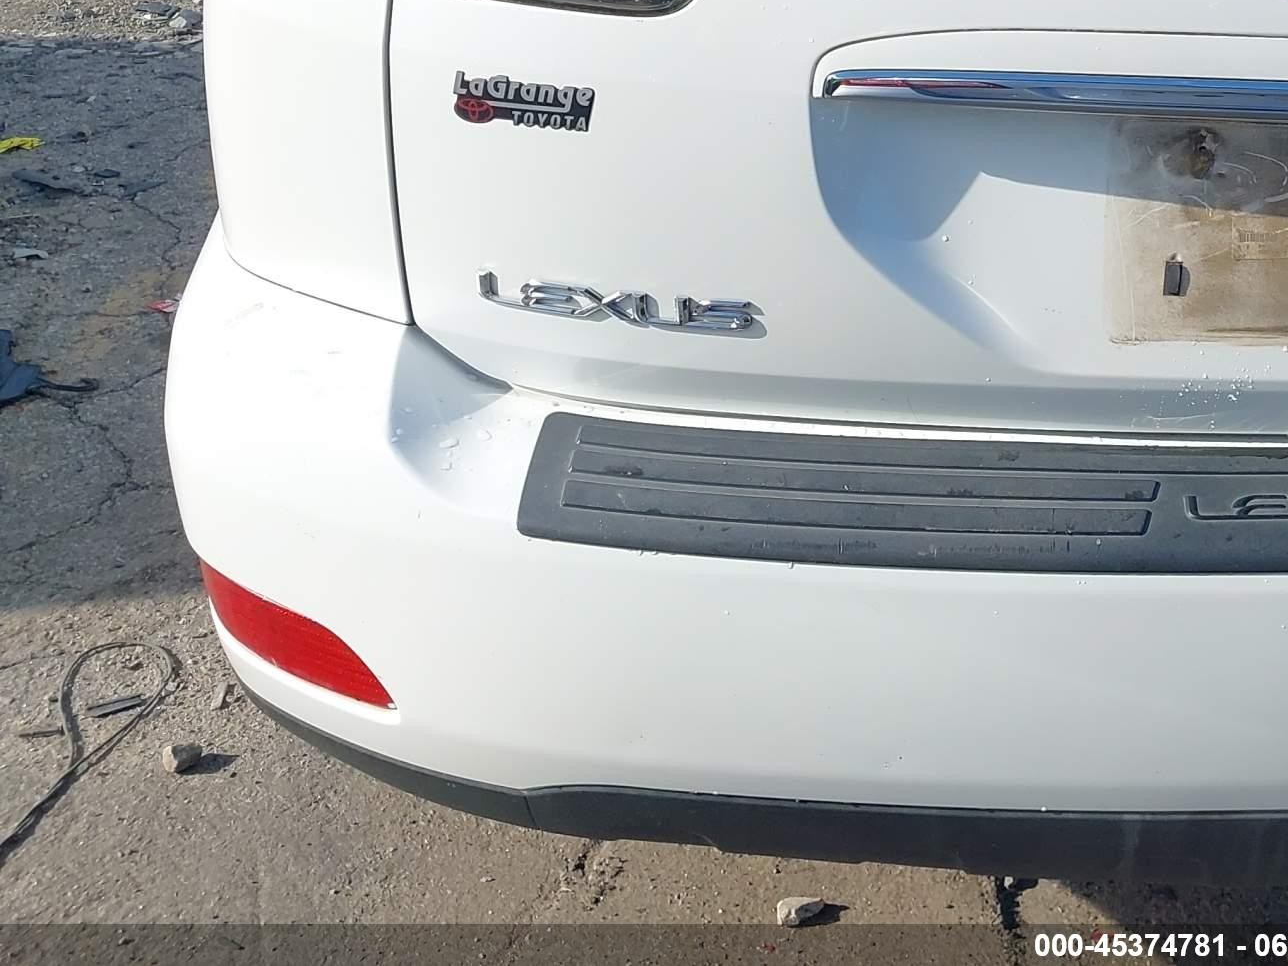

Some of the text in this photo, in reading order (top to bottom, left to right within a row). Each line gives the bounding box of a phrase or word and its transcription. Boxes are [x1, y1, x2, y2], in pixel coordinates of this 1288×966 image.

[453, 71, 594, 113] LaGrange
[511, 110, 588, 132] TOYOTA
[477, 268, 766, 338] LEXUS
